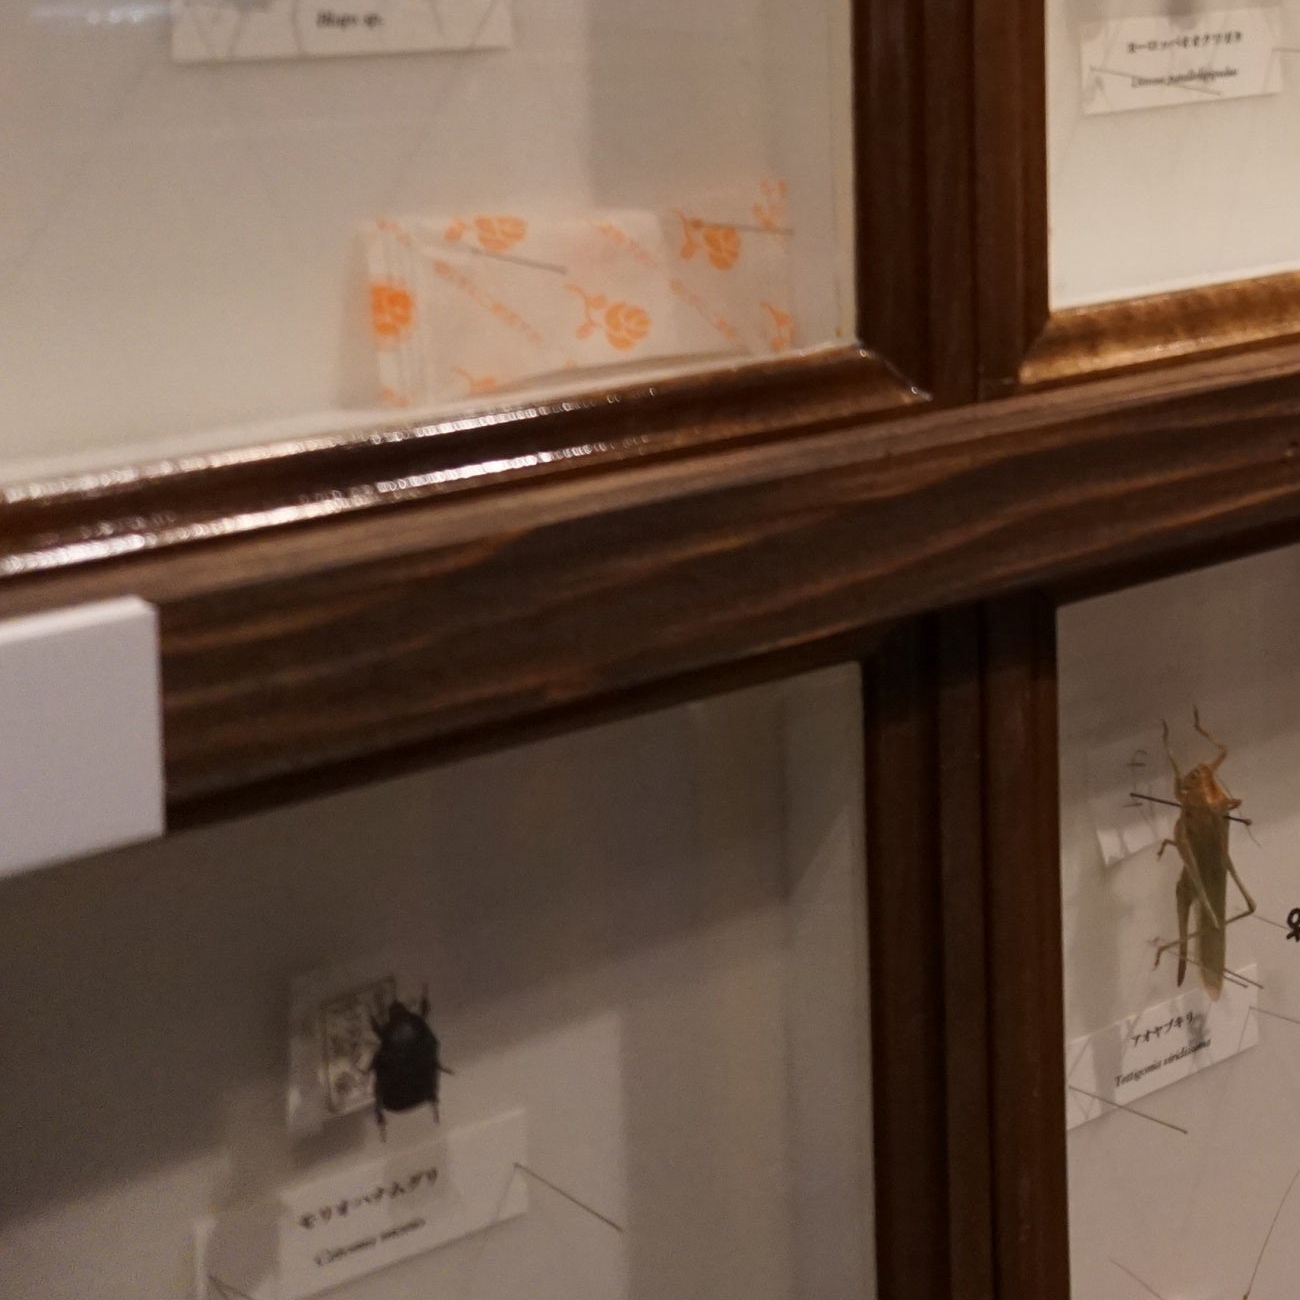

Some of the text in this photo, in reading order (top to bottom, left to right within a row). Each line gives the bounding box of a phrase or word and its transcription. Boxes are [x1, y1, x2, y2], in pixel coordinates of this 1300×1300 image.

[1131, 1011, 1193, 1047] アオヤブキリ
